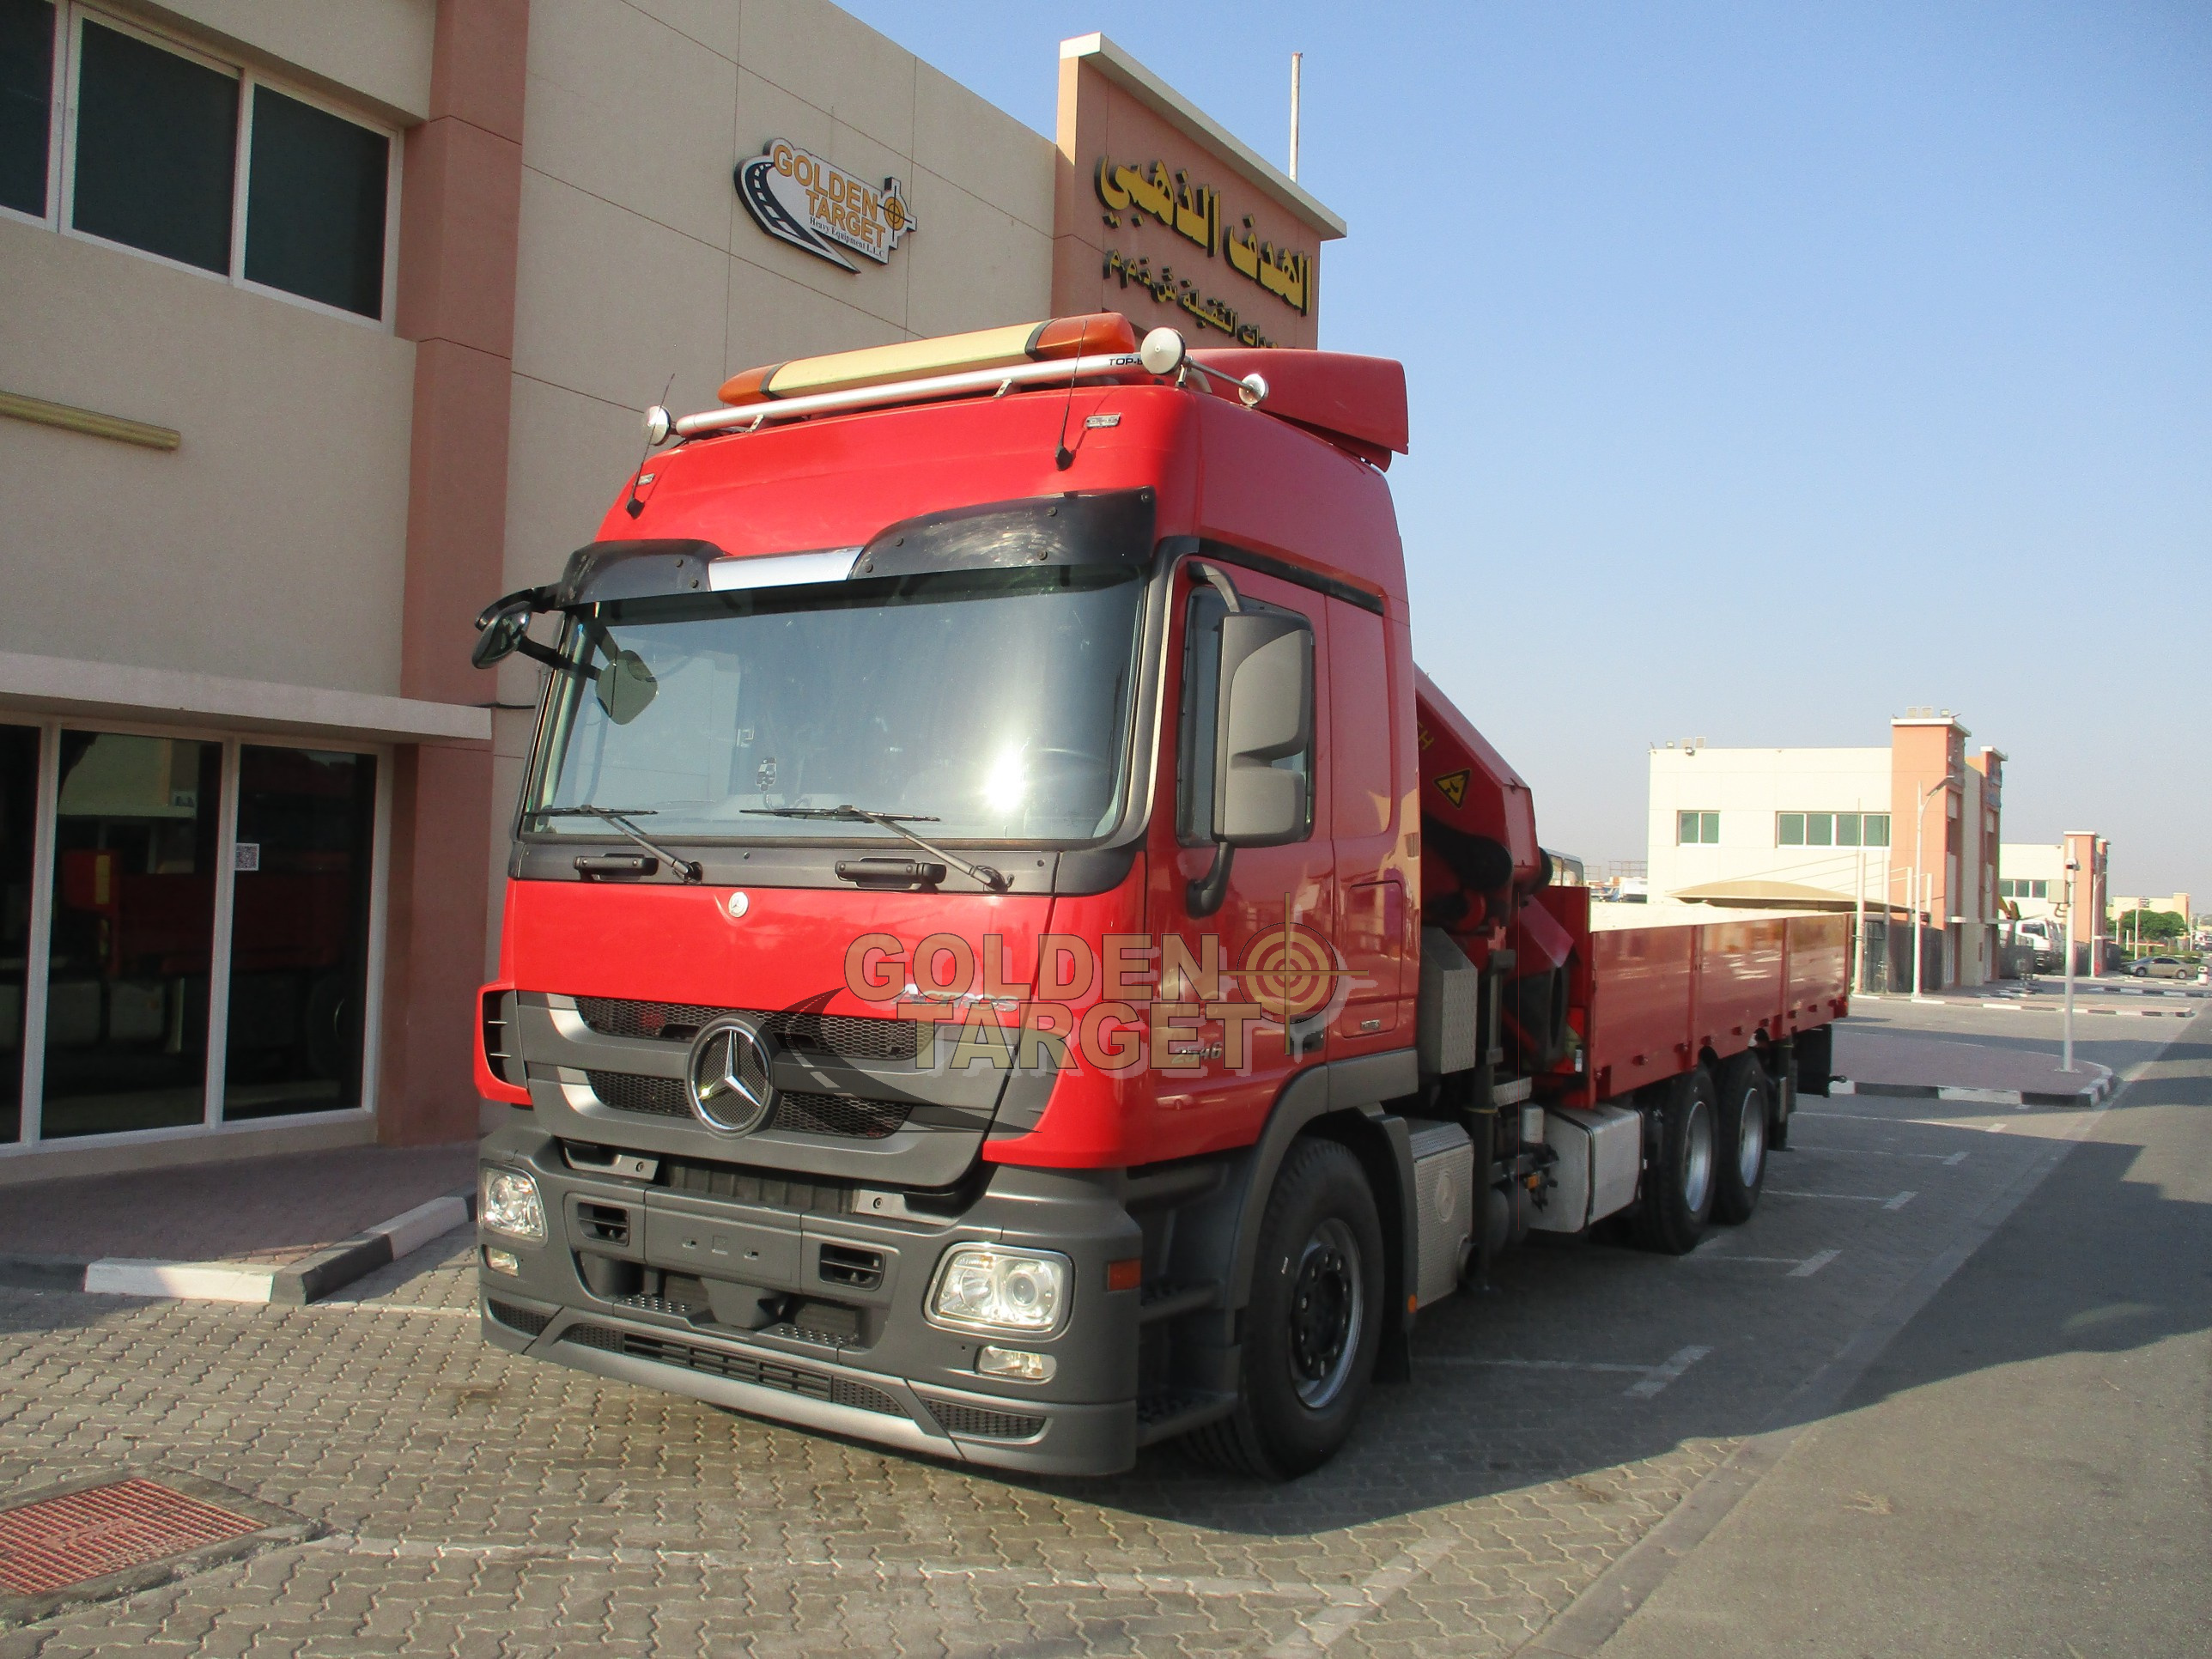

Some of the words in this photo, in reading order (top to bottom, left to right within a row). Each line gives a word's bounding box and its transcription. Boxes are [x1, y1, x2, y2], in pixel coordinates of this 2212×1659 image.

[774, 144, 878, 221] GOLDEN
[1097, 155, 1220, 257] الذهبي
[805, 189, 885, 248] TARGET
[810, 216, 830, 234] Heavy
[831, 226, 866, 248] Equipment
[1224, 214, 1311, 316] الهدف
[1171, 1041, 1223, 1065] 2546
